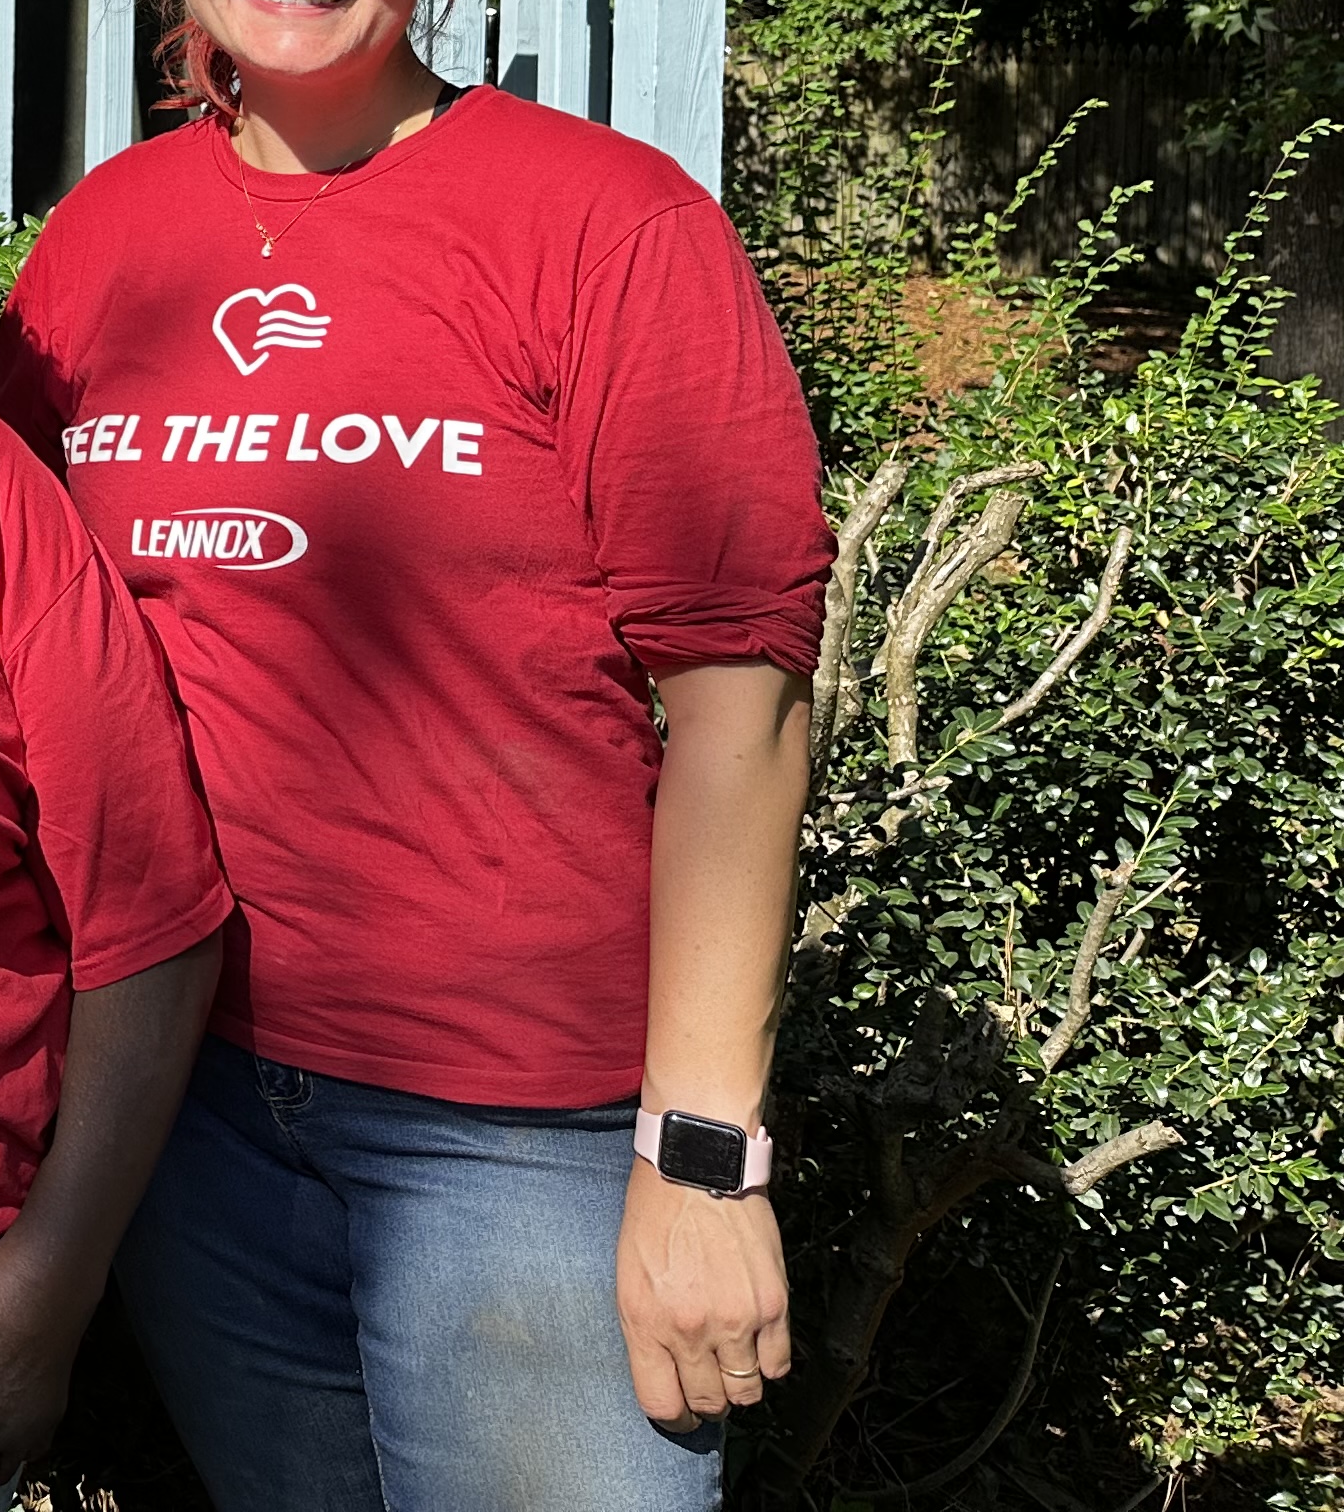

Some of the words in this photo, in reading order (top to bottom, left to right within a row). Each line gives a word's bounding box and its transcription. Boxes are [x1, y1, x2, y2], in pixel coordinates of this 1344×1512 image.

[61, 414, 143, 466] FEEL
[161, 414, 279, 463] THE
[285, 413, 484, 476] LOVE
[131, 518, 268, 561] LENNOX
